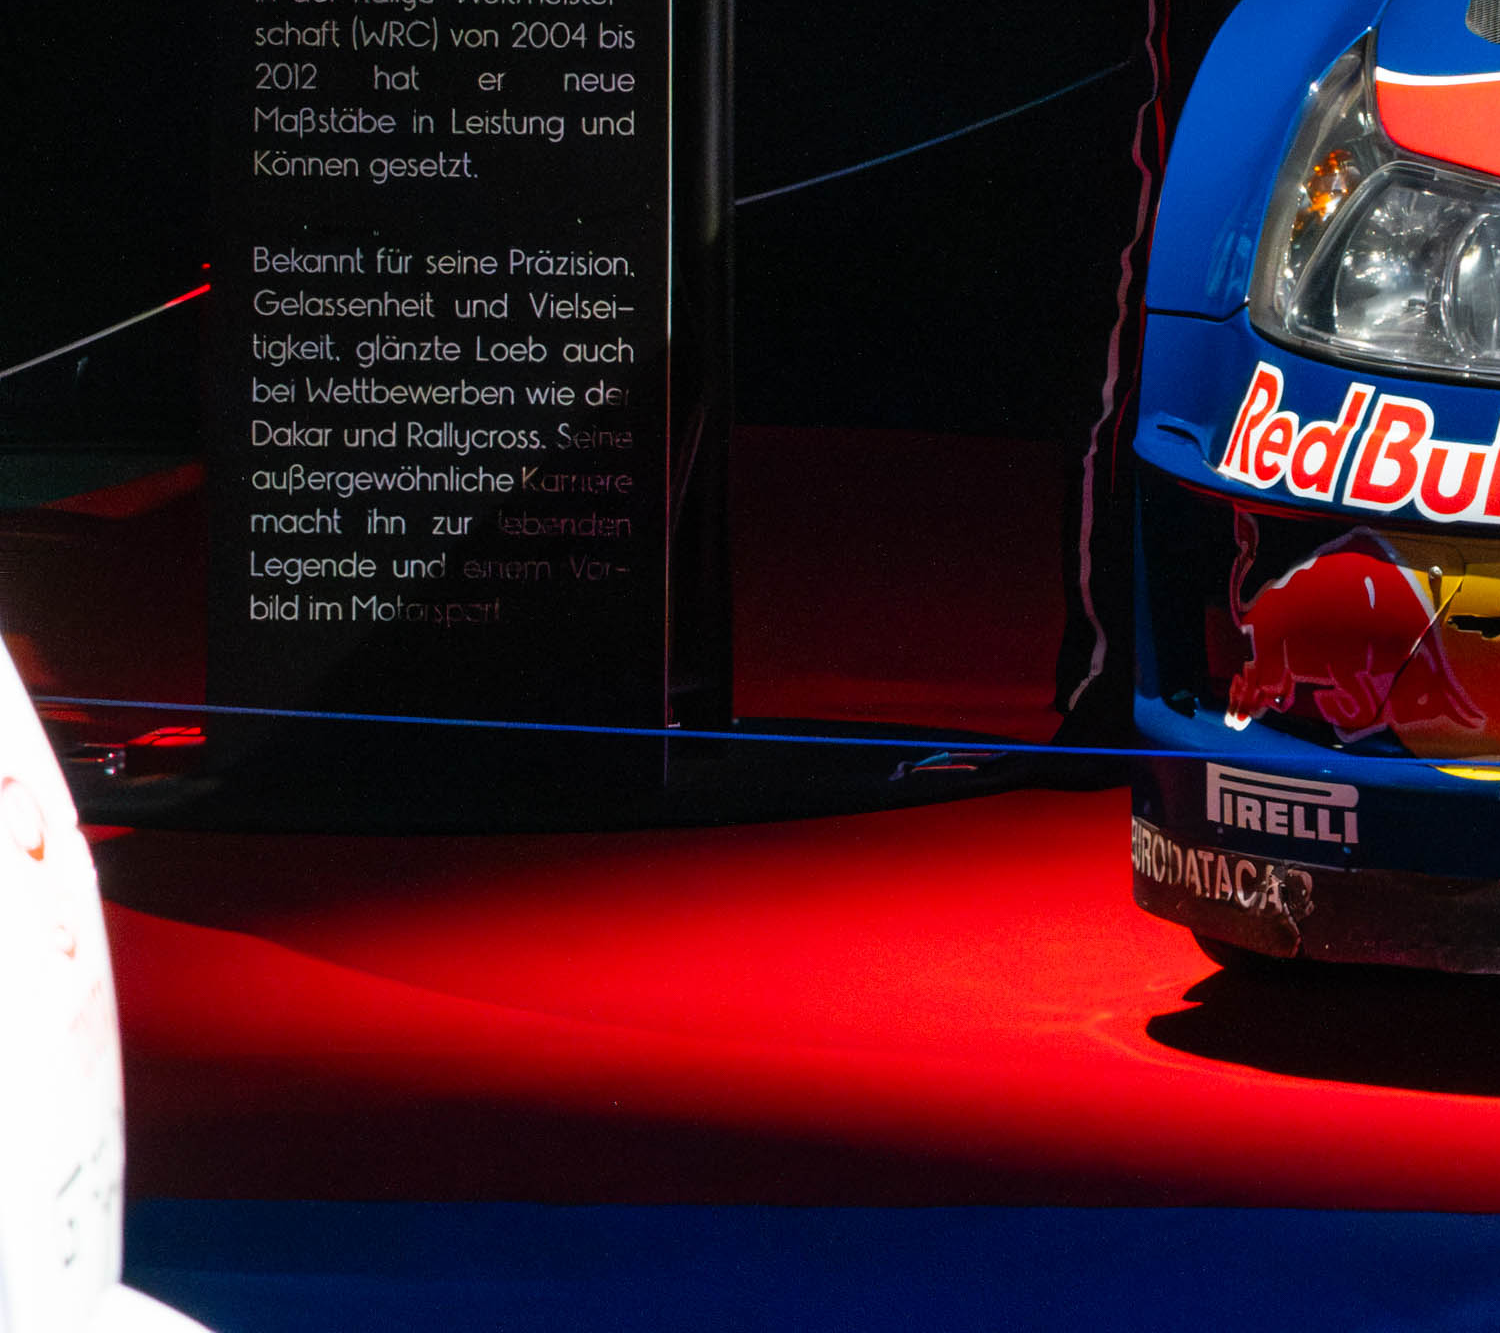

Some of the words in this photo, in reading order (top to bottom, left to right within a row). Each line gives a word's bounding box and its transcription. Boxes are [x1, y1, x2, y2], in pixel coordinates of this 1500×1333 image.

[255, 20, 340, 48] schaft
[351, 15, 439, 52] (WRC)
[450, 28, 500, 49] von
[511, 20, 587, 49] 2004
[598, 21, 636, 50] bis
[254, 62, 318, 91] 2012
[373, 64, 420, 91] hat
[477, 71, 505, 92] er
[563, 72, 636, 93] neue
[253, 106, 397, 139] Maßstäbe
[412, 108, 435, 134] in
[451, 107, 565, 143] Leistung
[581, 109, 635, 137] und
[253, 149, 360, 177] Können
[368, 151, 478, 185] gesetzt.
[253, 246, 365, 274] Bekannt
[376, 247, 413, 275] für
[426, 248, 499, 276] seine
[509, 248, 635, 278] Präzision,
[253, 288, 435, 318] Gelassenheit
[454, 292, 509, 319] und
[528, 292, 634, 320] Vielsei-
[252, 333, 341, 368] tigkeit,
[355, 334, 462, 369] glänzte
[475, 335, 548, 363] Loeb
[562, 336, 635, 364] auch
[251, 377, 296, 403] bei
[305, 377, 515, 406] Wettbewerben
[525, 380, 576, 407] wie
[251, 419, 333, 447] Dakar
[343, 421, 397, 448] und
[407, 421, 546, 457] Rallycross.
[1231, 369, 1368, 496] Red
[252, 464, 514, 498] außergewöhnliche
[250, 507, 342, 535] macht
[367, 507, 407, 535] ihn
[431, 515, 473, 536] zur
[250, 550, 377, 584] Legende
[392, 552, 446, 579] und
[249, 594, 299, 622] bild
[308, 595, 343, 622] im
[1205, 763, 1360, 845] PIRELLI
